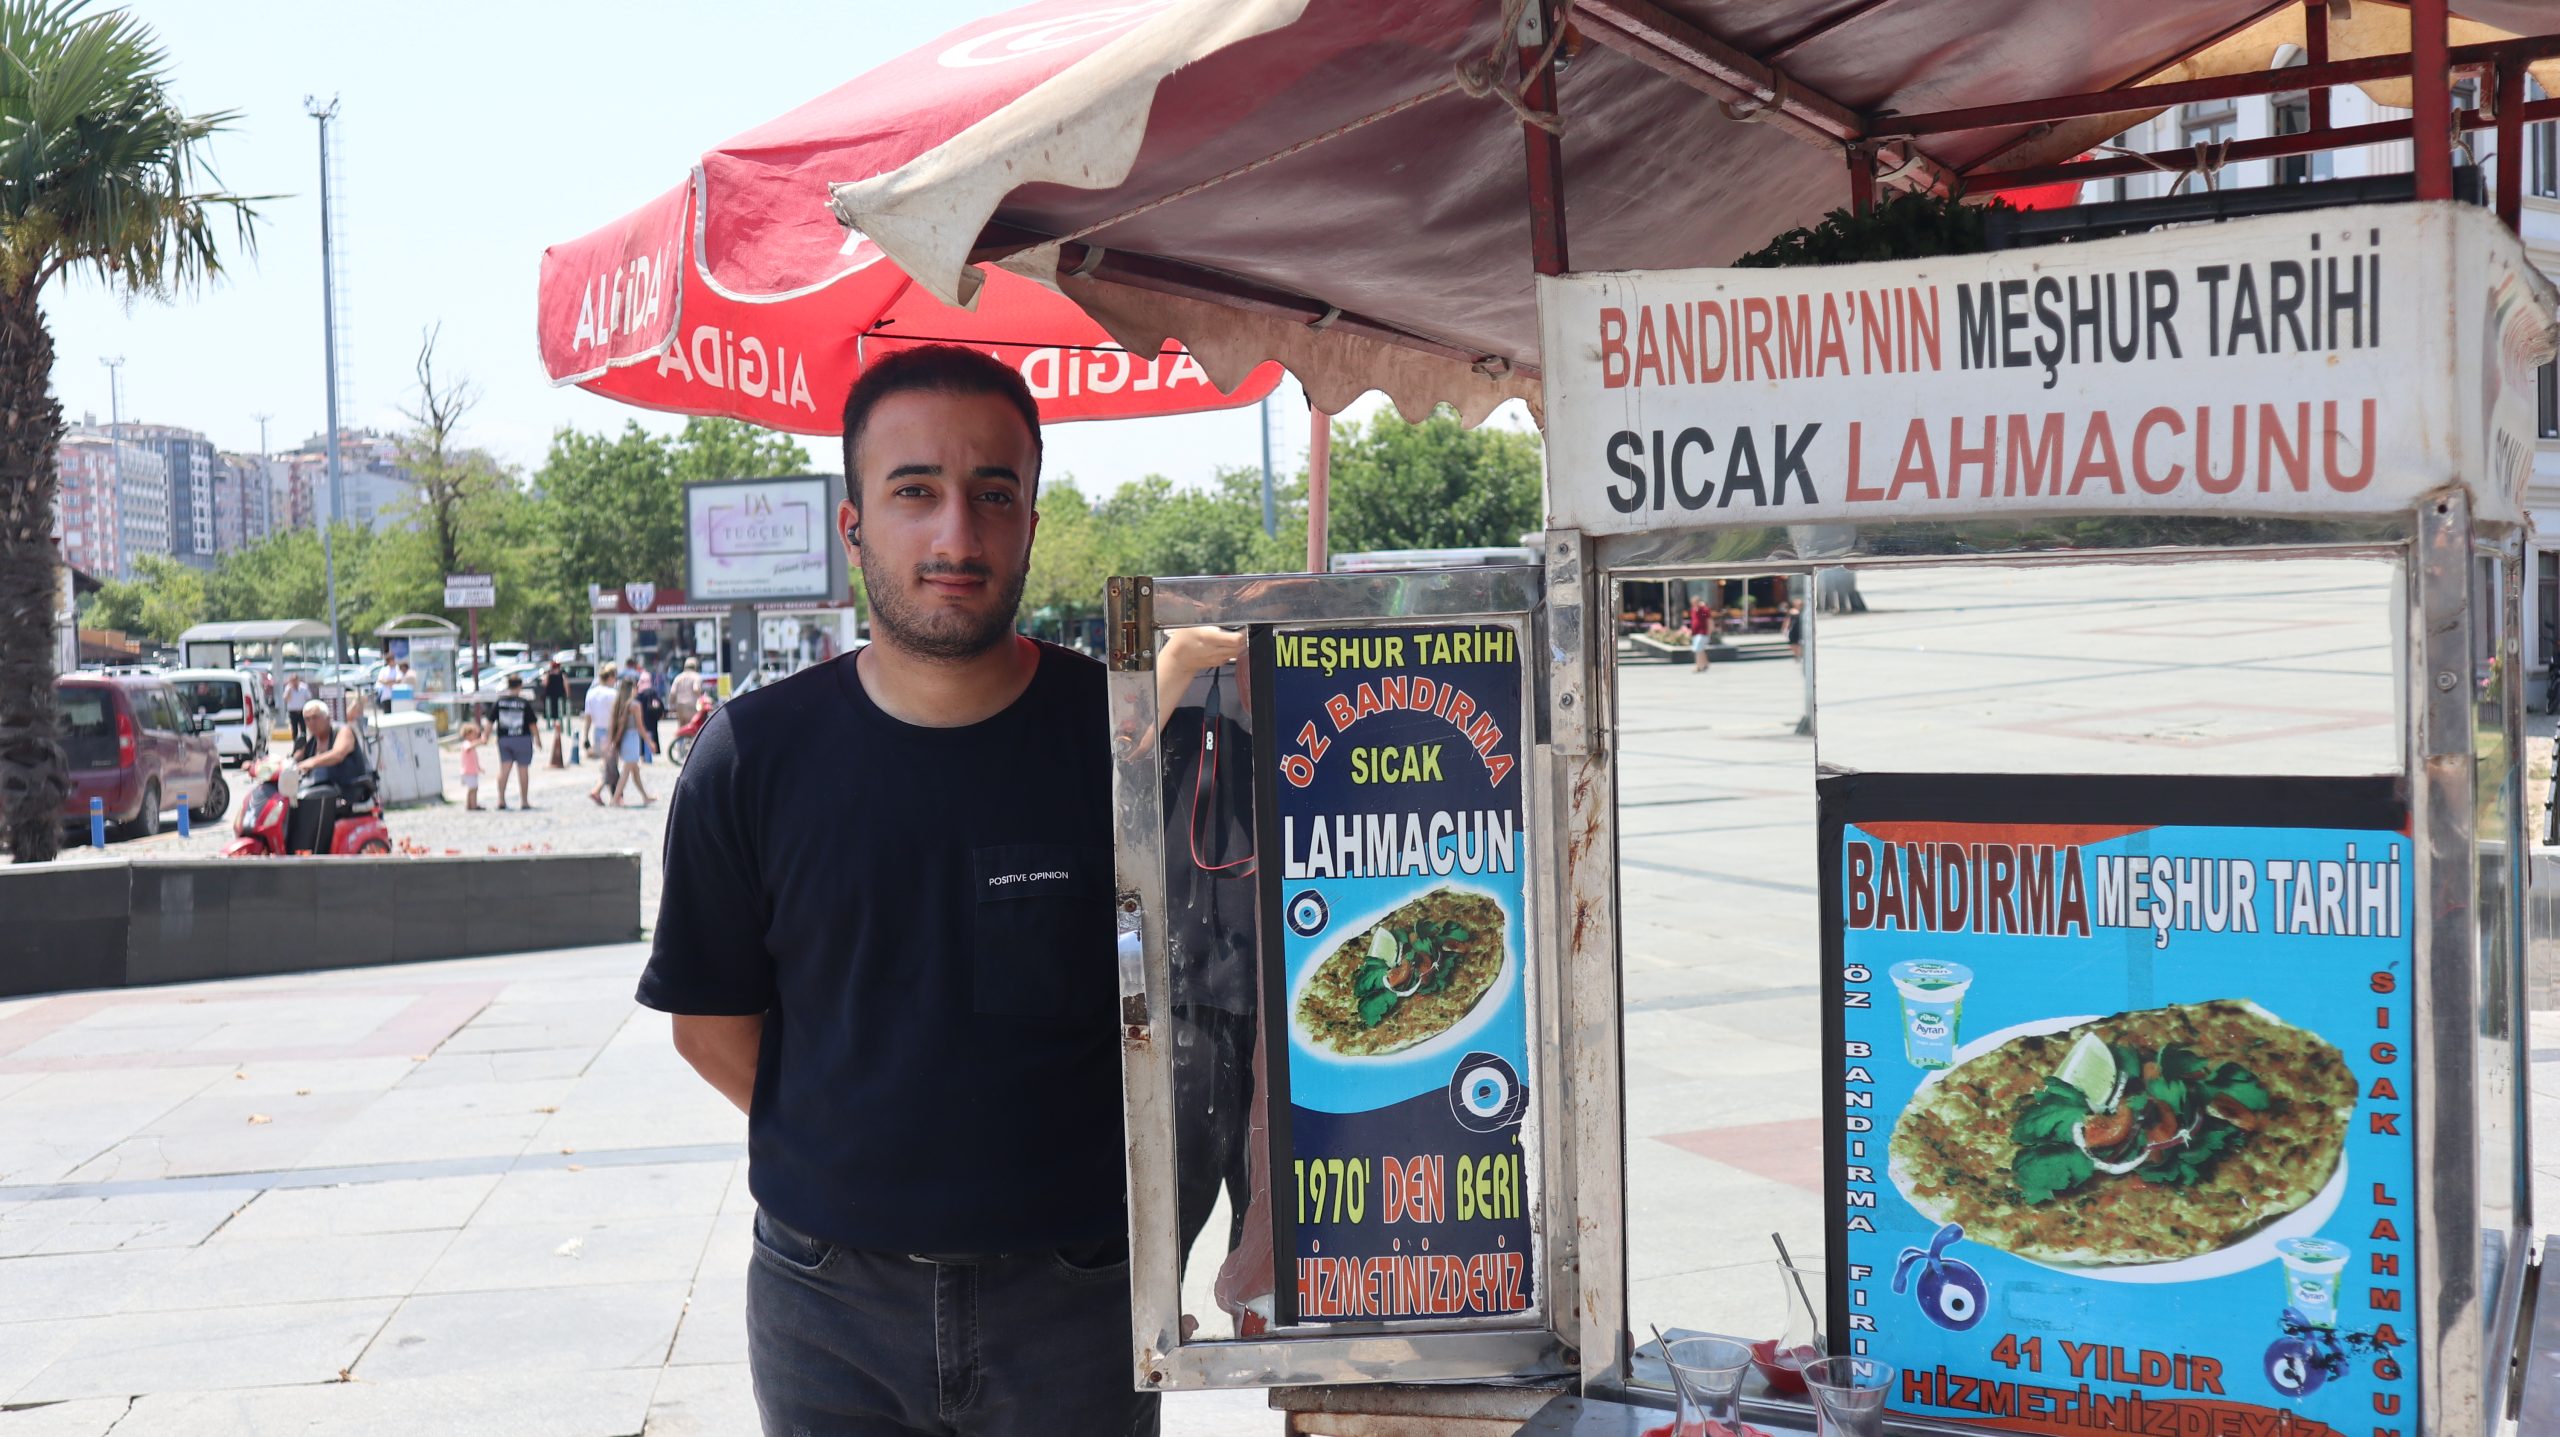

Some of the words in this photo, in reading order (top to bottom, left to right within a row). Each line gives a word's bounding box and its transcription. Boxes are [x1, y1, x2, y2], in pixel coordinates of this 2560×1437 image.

[1600, 285, 1941, 389] BANDIRMA’NIN
[1957, 269, 2183, 389] MEŞHUR
[2197, 228, 2380, 357] TARİHİ
[1606, 423, 1822, 514] SICAK
[1845, 398, 2377, 502] LAHMACUNU
[1275, 634, 1405, 677] MEŞHUR
[1280, 720, 1332, 788] ÖZ
[1325, 675, 1515, 788] BANDIRMA
[1351, 744, 1444, 784] SICAK
[988, 873, 1027, 886] POSITIVE
[1029, 871, 1069, 881] OPINION
[1283, 809, 1515, 879] LAHMACUN
[1846, 841, 2093, 939] BANDIRMA
[2096, 855, 2259, 950] MEŞHUR
[2266, 842, 2401, 938] TARİHİ
[1844, 963, 1872, 1008] ÖZ
[1916, 1024, 1944, 1035] Ayran
[2368, 971, 2402, 1137] SICAK
[1382, 1154, 1445, 1224] DEN
[1456, 1134, 1520, 1221] BERİ
[1845, 1041, 1877, 1234] BANDIRMA
[1296, 1234, 1527, 1317] HİZMETİNİZDEYİZ
[1991, 1333, 2041, 1373] 41
